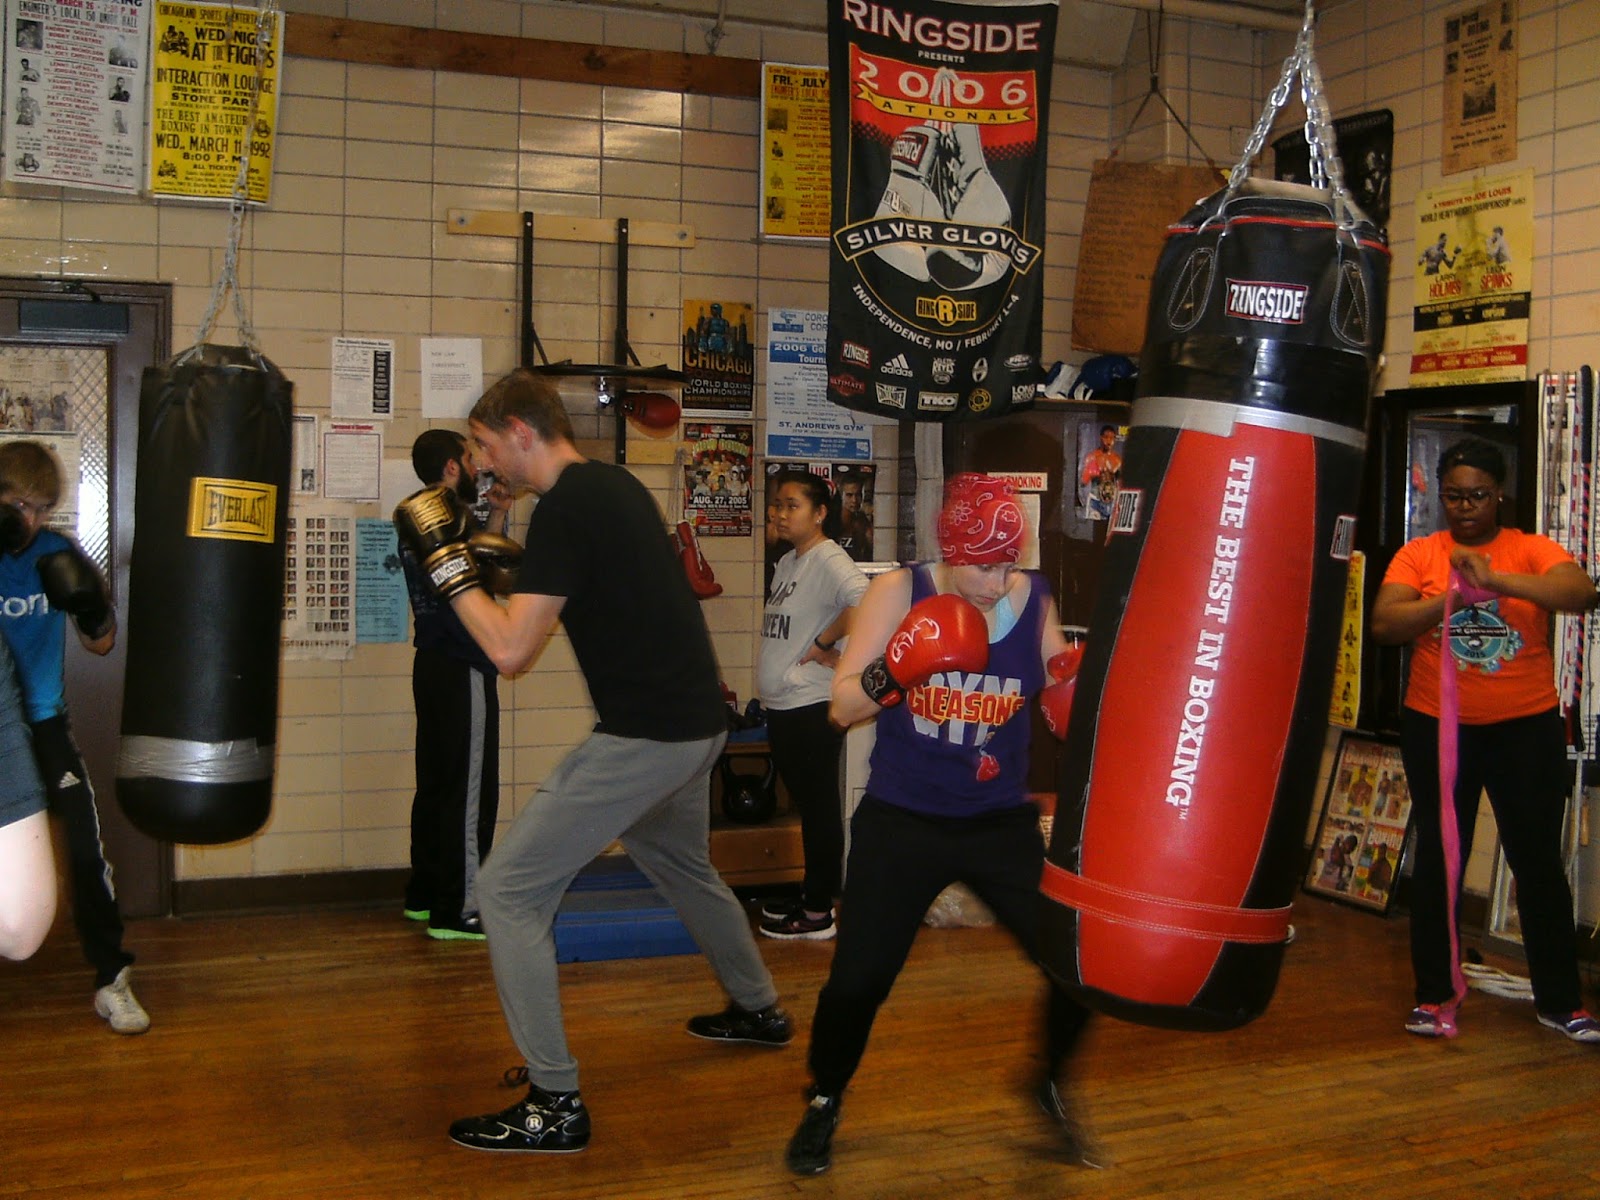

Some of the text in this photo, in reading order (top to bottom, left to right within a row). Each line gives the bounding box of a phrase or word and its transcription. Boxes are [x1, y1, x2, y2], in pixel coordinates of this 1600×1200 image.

[60, 7, 82, 20] LOCAL
[843, 0, 1042, 53] RINGSIDE
[191, 42, 209, 62] AT
[227, 44, 275, 69] FIGHS
[917, 50, 966, 64] PRESENTS
[157, 68, 229, 88] INTERACTION
[800, 77, 827, 88] JULY
[858, 57, 1028, 105] 2006
[171, 92, 251, 107] STONE PAR
[156, 108, 248, 126] THE BEST AMATEUR
[161, 121, 196, 133] BOXING
[200, 124, 209, 134] IN
[189, 135, 229, 153] MARCH
[182, 152, 210, 162] 8:00
[1474, 191, 1487, 201] JOE
[1488, 186, 1512, 198] LOUIS
[846, 221, 934, 250] SILVER
[1480, 272, 1513, 291] SPINKS
[1229, 283, 1304, 320] RINGSIDE
[851, 283, 933, 350] INDEPENDENCE,
[935, 334, 954, 351] MO
[774, 342, 808, 352] 2006
[880, 365, 914, 378] adidas
[684, 386, 752, 397] CHAMPIONSHIPS
[795, 422, 841, 430] ANDREWS
[843, 424, 864, 432] GYM
[693, 495, 713, 505] AUG.
[728, 496, 747, 505] 2005
[1218, 455, 1256, 529] THE
[430, 555, 470, 587] RINGSIDE
[1204, 534, 1242, 625] BEST
[0, 592, 49, 617] on
[1193, 627, 1225, 671] IN
[1164, 674, 1216, 808] BOXING
